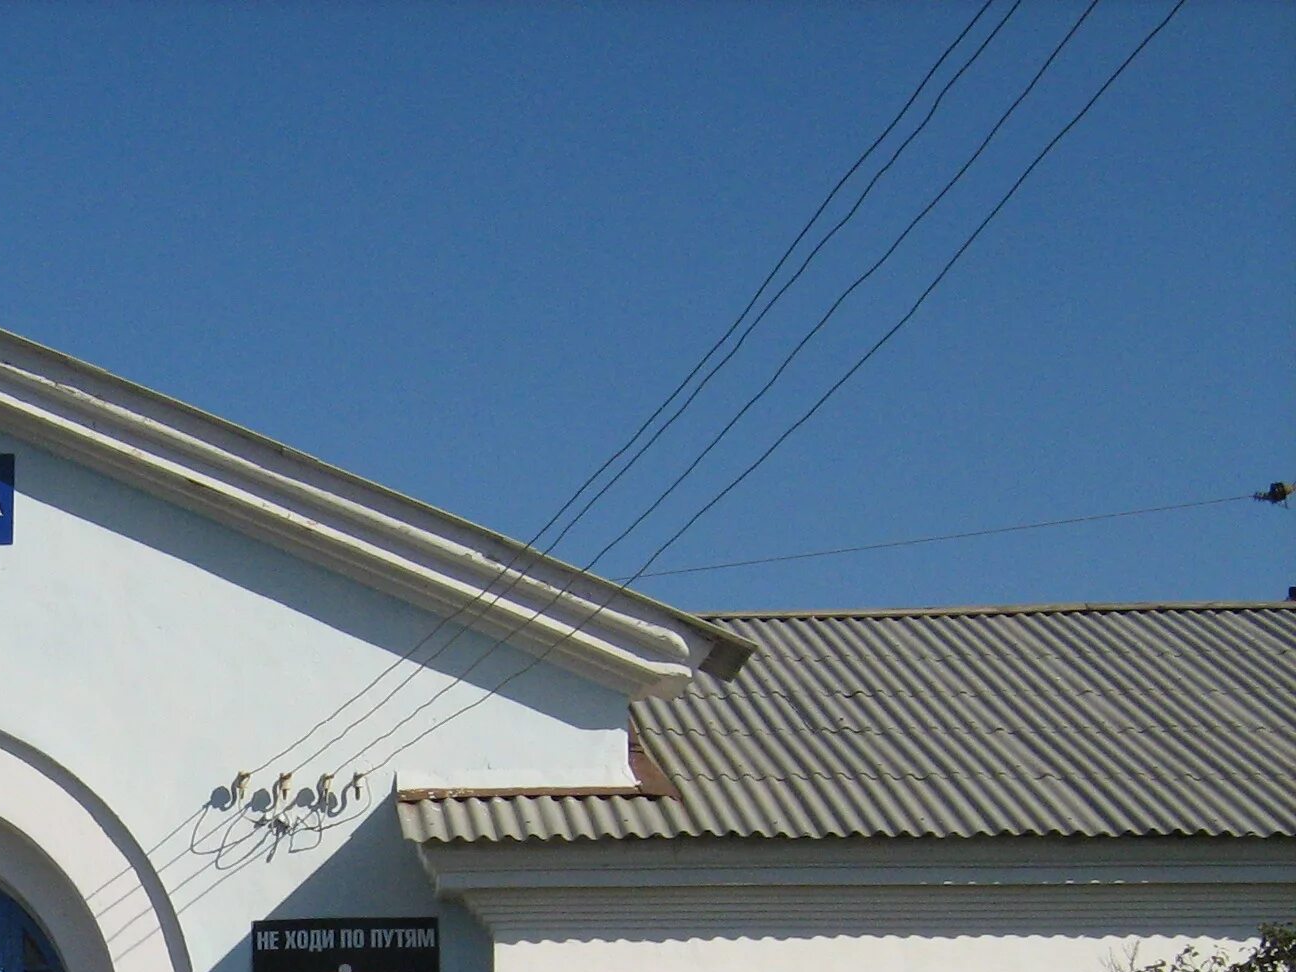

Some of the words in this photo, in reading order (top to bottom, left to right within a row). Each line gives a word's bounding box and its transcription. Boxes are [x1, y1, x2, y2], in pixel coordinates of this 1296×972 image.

[256, 930, 279, 951] НЕ
[284, 929, 335, 952] ХОДИ
[340, 928, 365, 949] ПО
[370, 928, 436, 949] ПУТЯМ
